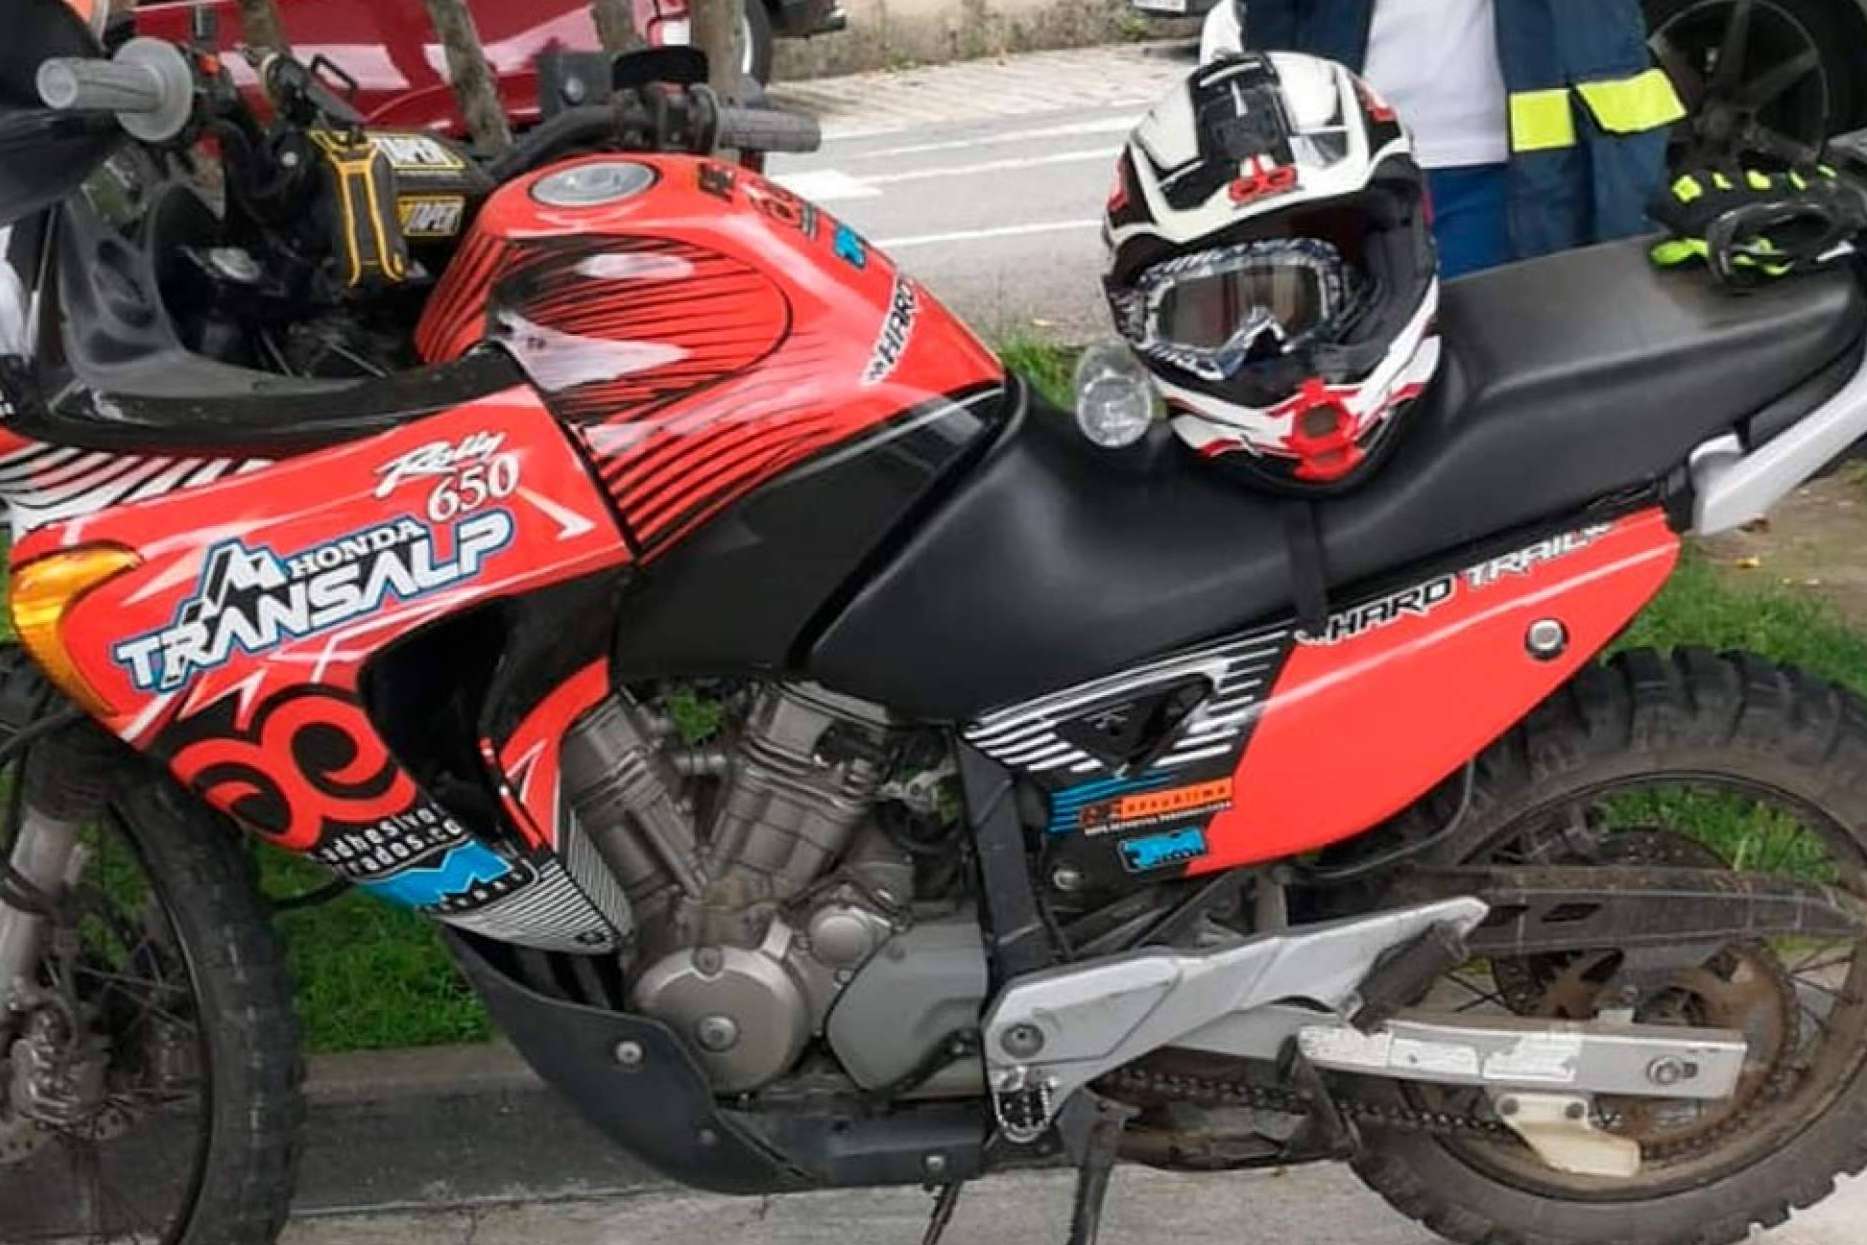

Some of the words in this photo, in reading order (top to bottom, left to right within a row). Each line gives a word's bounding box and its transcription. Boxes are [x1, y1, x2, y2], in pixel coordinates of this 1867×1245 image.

[429, 453, 519, 522] 650
[288, 516, 429, 578] HONDA
[114, 510, 514, 691] TRANSALP
[1326, 572, 1457, 643] HARD
